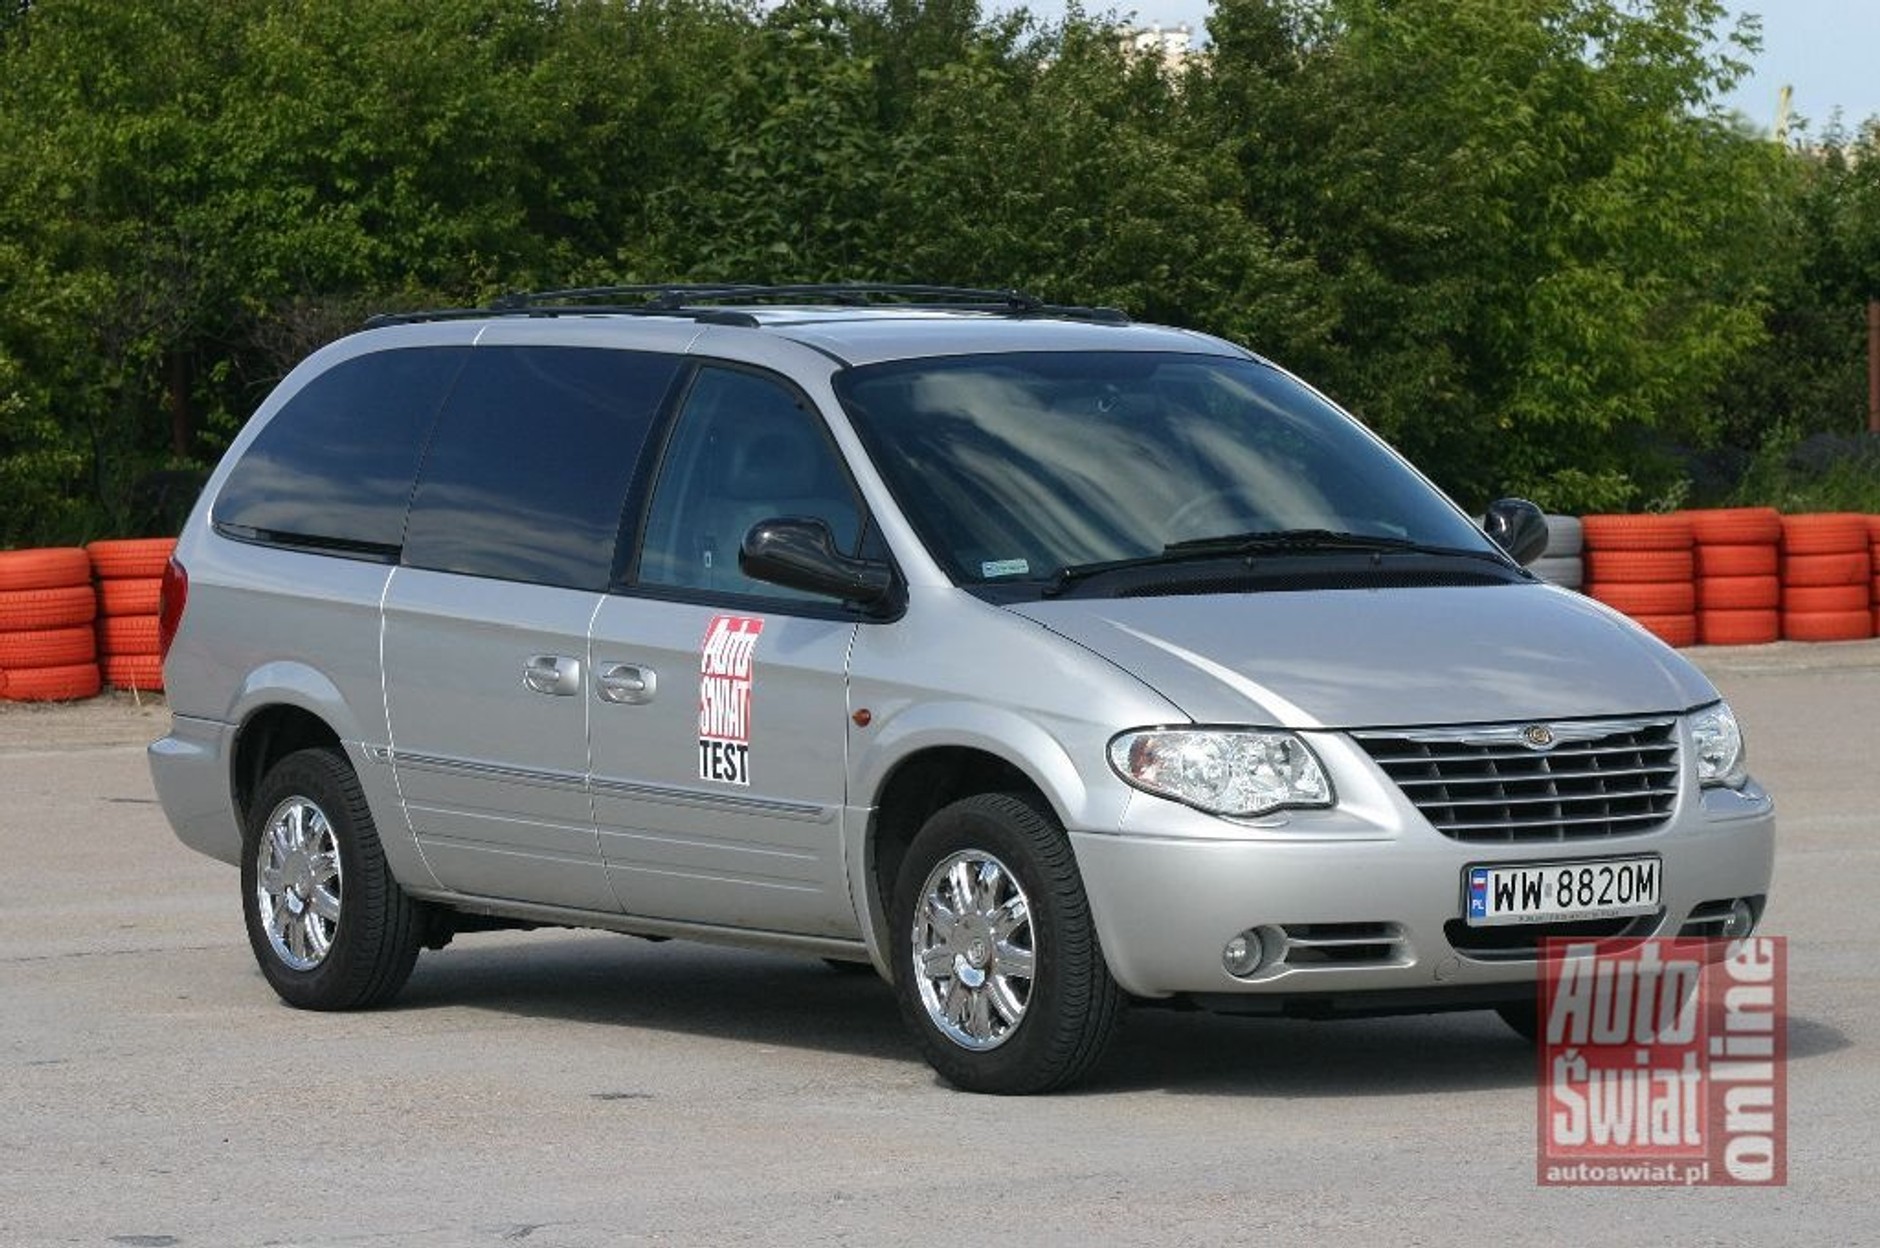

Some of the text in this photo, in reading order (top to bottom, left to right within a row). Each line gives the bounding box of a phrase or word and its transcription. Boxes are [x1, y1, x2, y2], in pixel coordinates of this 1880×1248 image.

[700, 740, 749, 783] TEST
[1472, 899, 1485, 911] PL
[1494, 863, 1654, 912] WW 8820M
